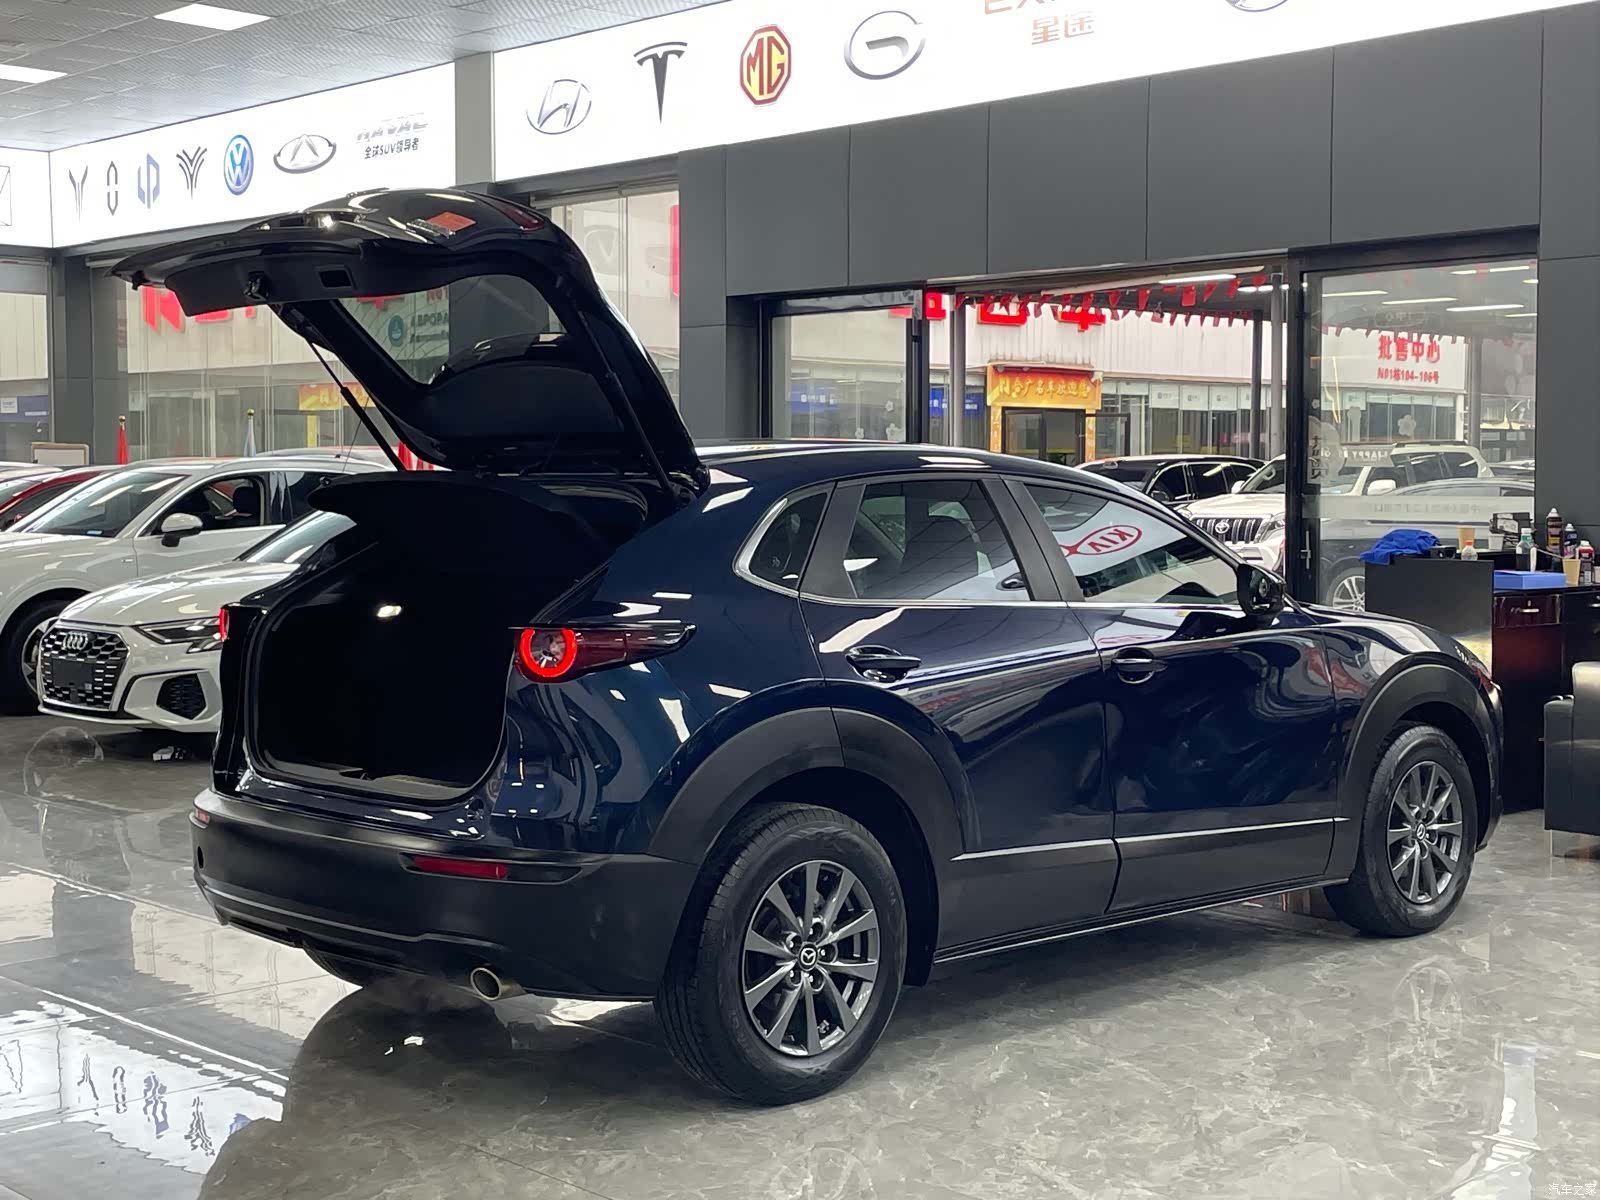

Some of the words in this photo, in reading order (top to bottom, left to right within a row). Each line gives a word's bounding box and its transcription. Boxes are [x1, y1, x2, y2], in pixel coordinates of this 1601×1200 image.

[1031, 10, 1095, 45] 星途
[745, 34, 787, 98] MG
[1378, 335, 1440, 363] 批售中心
